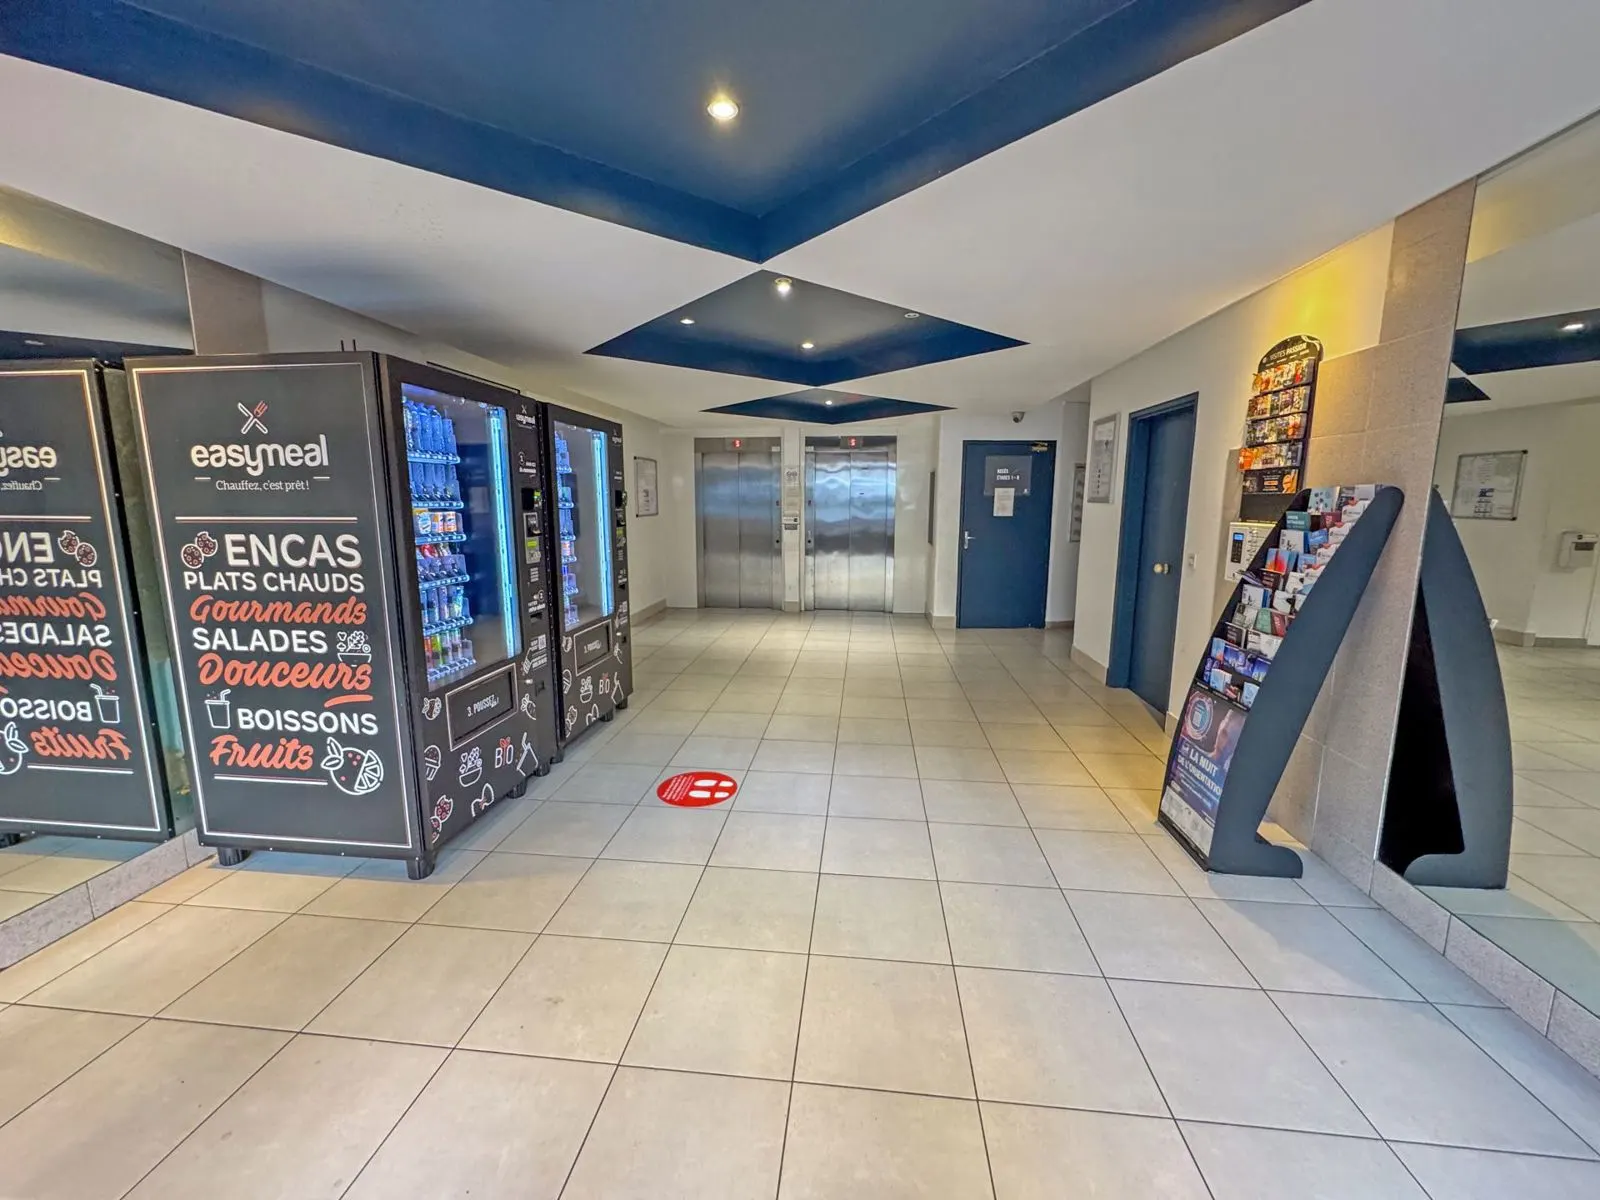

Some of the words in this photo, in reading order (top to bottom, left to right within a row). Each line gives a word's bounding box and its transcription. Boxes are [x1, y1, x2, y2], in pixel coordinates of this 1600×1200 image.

[191, 434, 329, 477] easymeal
[216, 480, 262, 491] Chauffez,
[263, 480, 284, 491] c'est
[224, 533, 363, 568] ENCAS
[183, 571, 257, 591] PLATS
[262, 572, 366, 594] CHAUDS
[190, 594, 368, 625] Gourmands
[192, 627, 328, 654] SALADES
[198, 652, 373, 691] Douceurs
[237, 708, 379, 735] BOISSONS
[209, 734, 314, 771] Fruits
